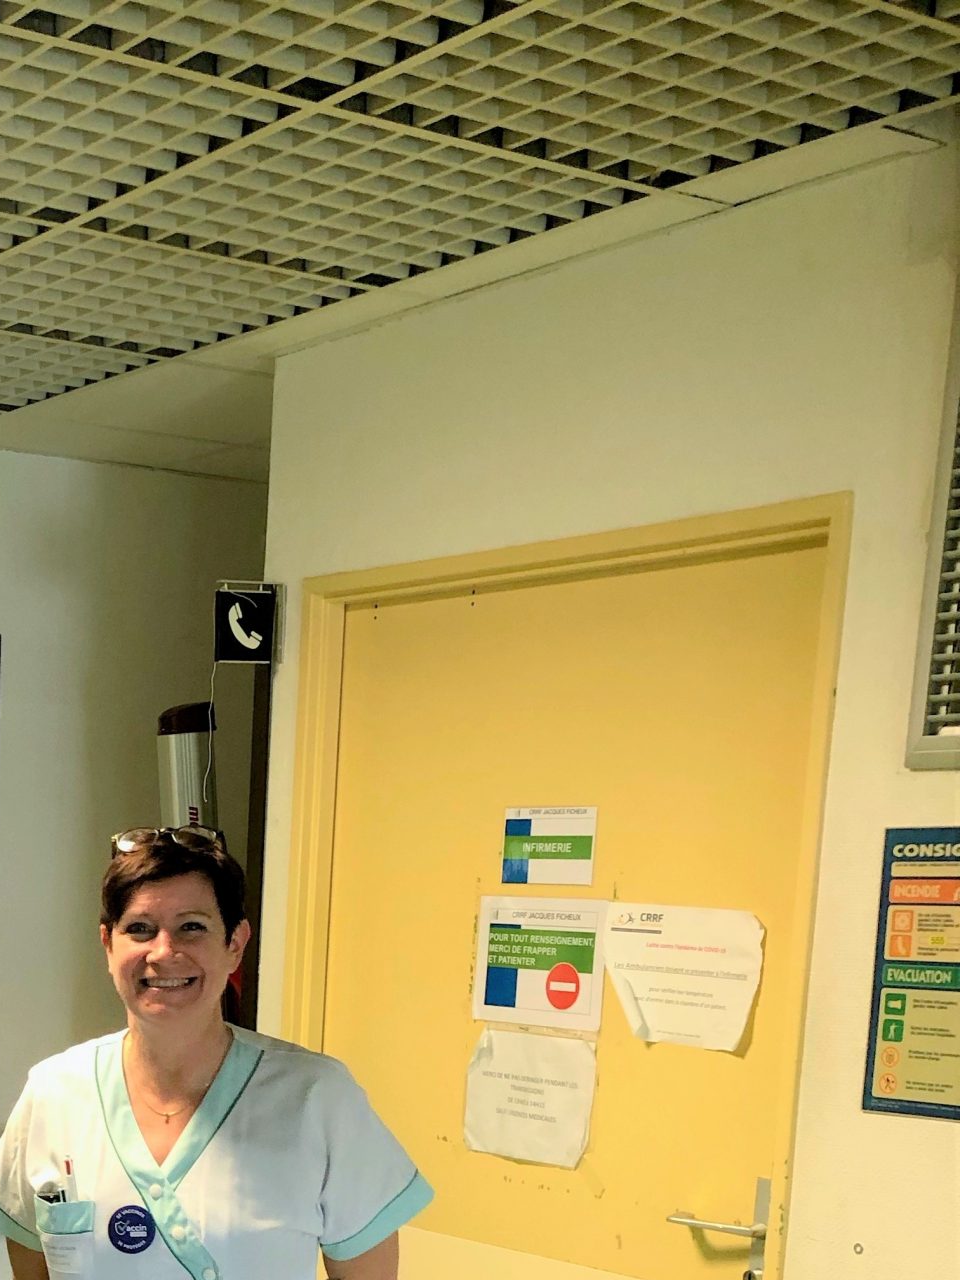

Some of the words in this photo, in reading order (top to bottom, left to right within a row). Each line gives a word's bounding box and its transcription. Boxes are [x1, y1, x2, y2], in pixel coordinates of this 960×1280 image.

[523, 842, 572, 853] INFIRMERIE
[893, 884, 941, 898] INCENDIE
[529, 912, 555, 920] JACQUES
[640, 913, 664, 922] CRRF
[489, 933, 510, 942] POUR
[511, 934, 529, 942] TOUT
[489, 944, 510, 953] MERCI
[512, 945, 522, 954] DE
[523, 946, 557, 956] FRAPPER
[488, 955, 498, 963] ET
[498, 955, 536, 966] PATIENTER
[887, 968, 952, 983] EVACUATION
